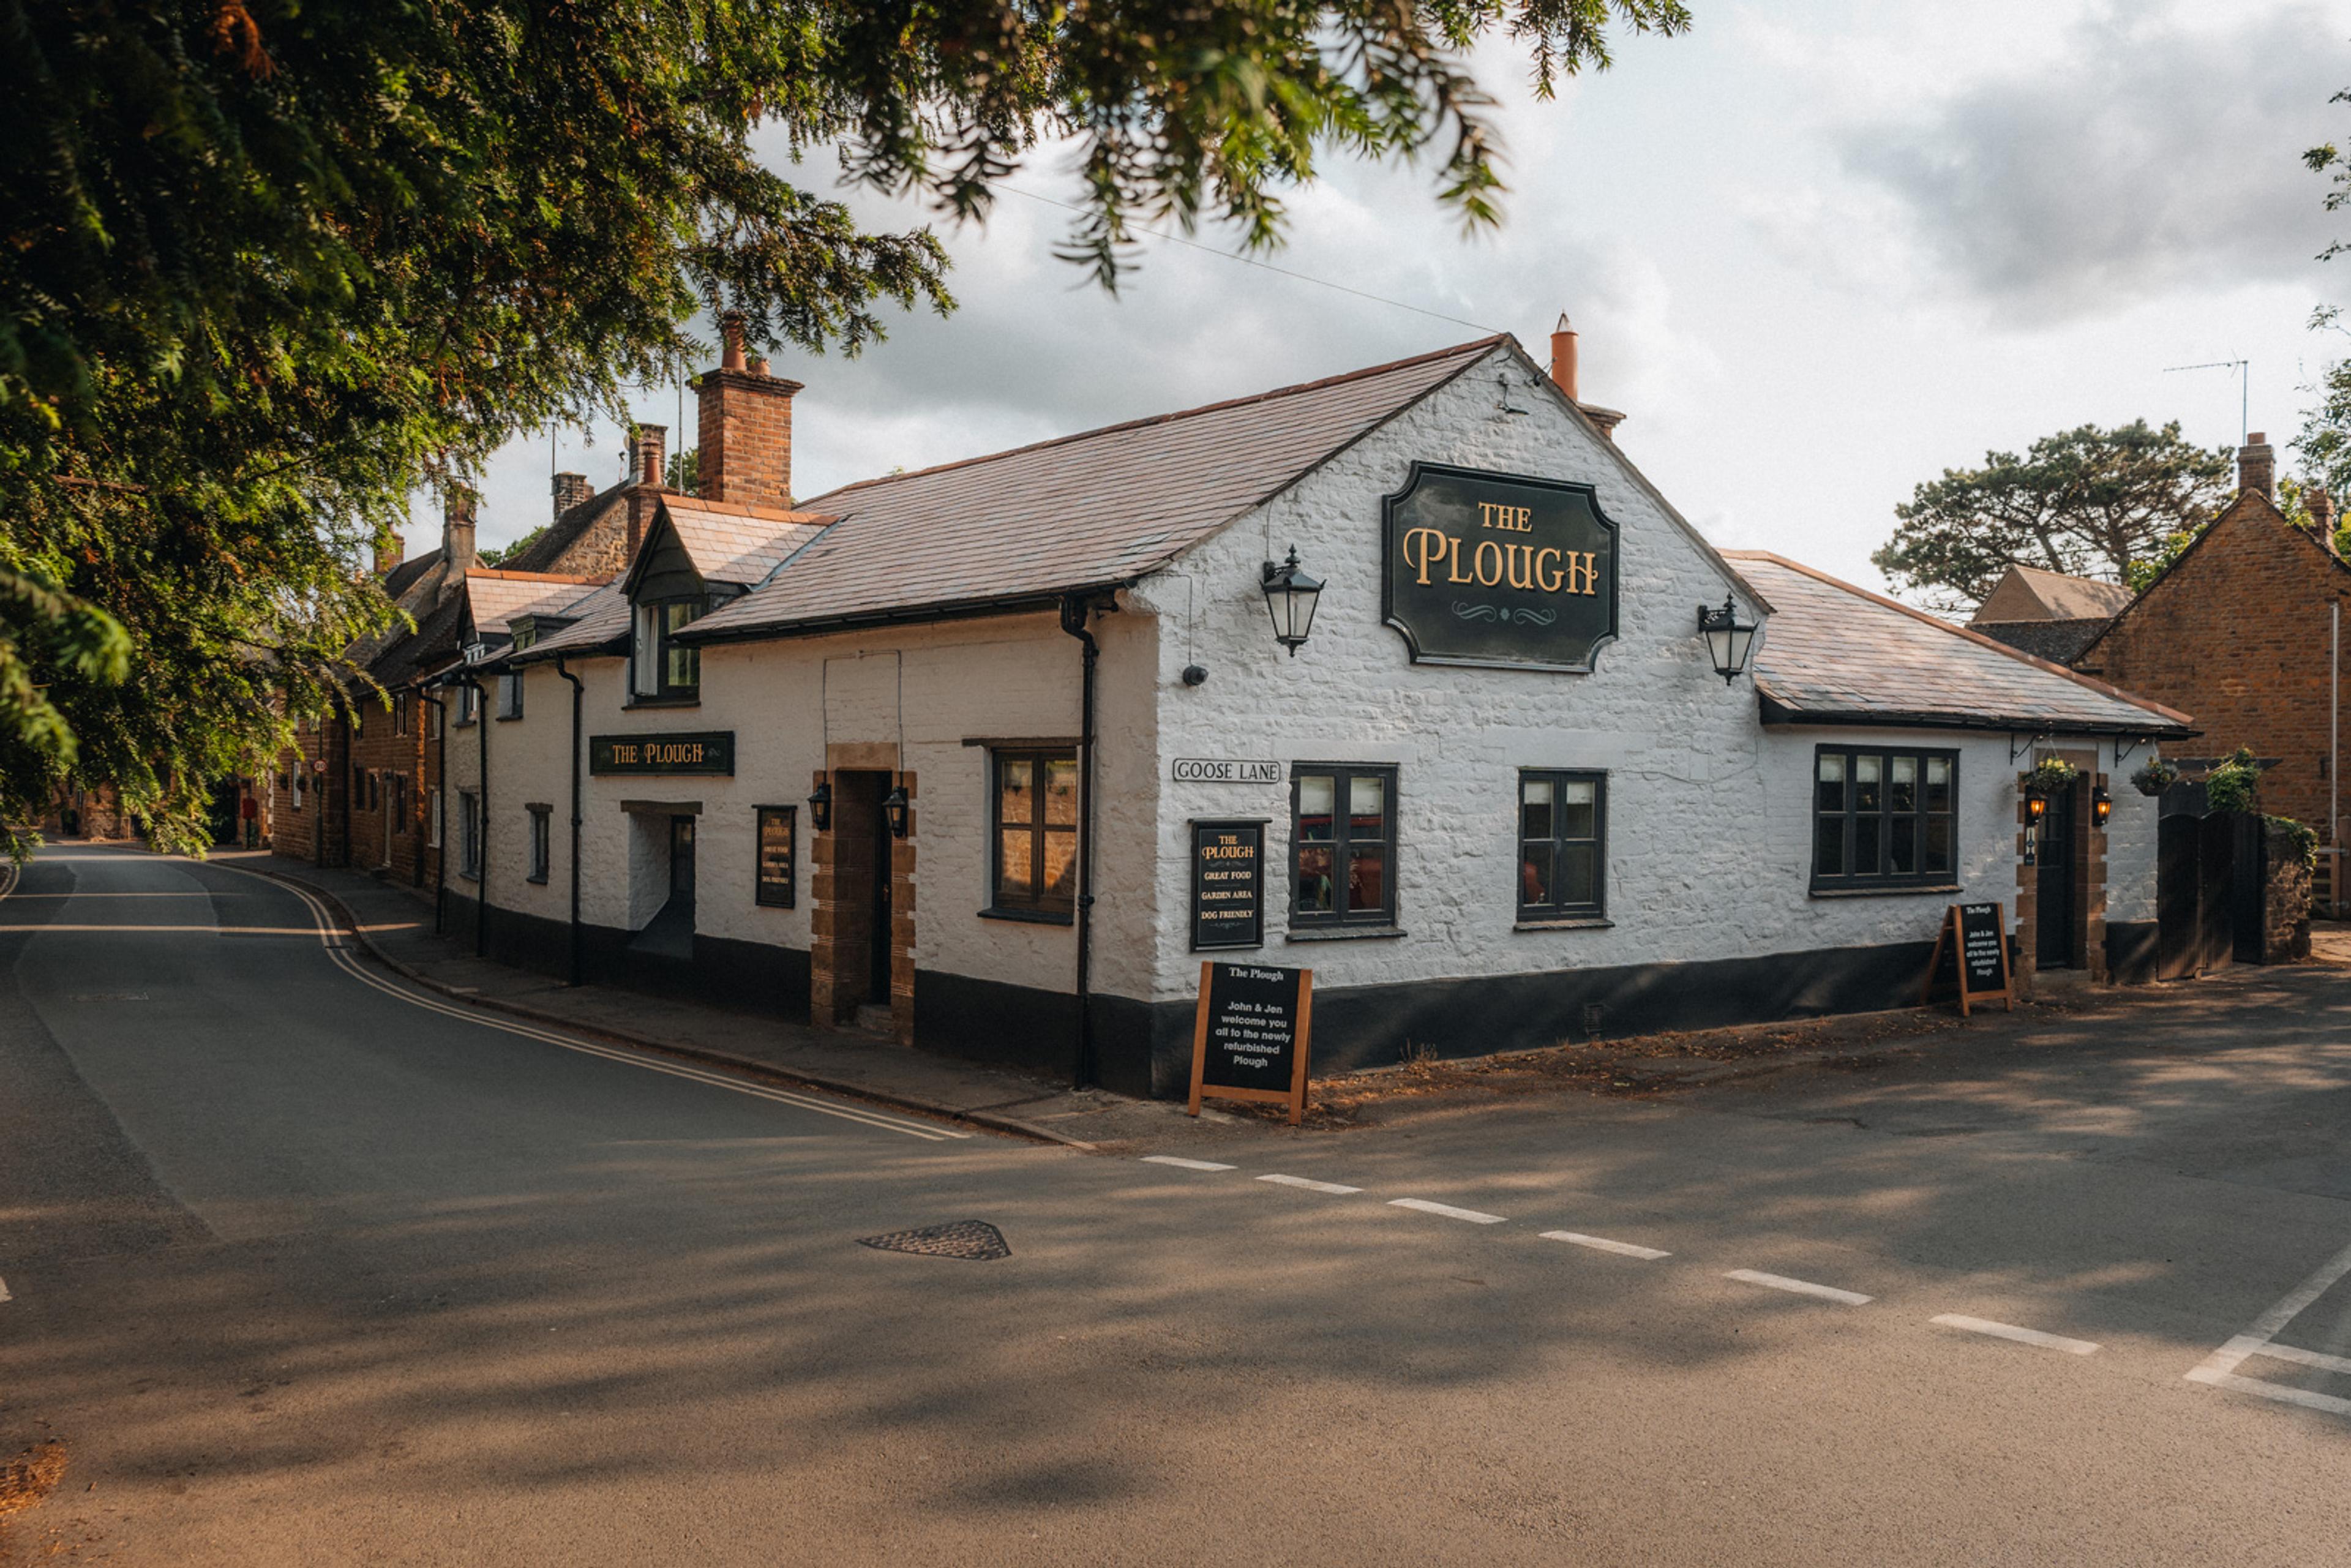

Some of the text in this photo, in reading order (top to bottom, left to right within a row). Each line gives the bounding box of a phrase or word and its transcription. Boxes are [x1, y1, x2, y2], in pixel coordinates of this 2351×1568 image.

[1478, 501, 1532, 533] THE
[1403, 527, 1599, 596] PLOUGH
[612, 743, 705, 764] THE PLOUGH
[1177, 762, 1278, 781] GOOSE LANE
[1218, 835, 1238, 844] THE
[1201, 846, 1254, 860] PLOUGH
[1204, 871, 1251, 881] GREAT FOOD
[1201, 890, 1253, 900] GARDEN AREA
[1201, 910, 1254, 920] DOG FRIENDLY
[1229, 967, 1284, 982] The Plough
[1228, 1001, 1283, 1014] John & Jen
[1221, 1015, 1287, 1029] welcome you
[1215, 1027, 1291, 1043] all to the newly
[1224, 1041, 1280, 1054] refurbished
[1233, 1055, 1268, 1068] Plough
